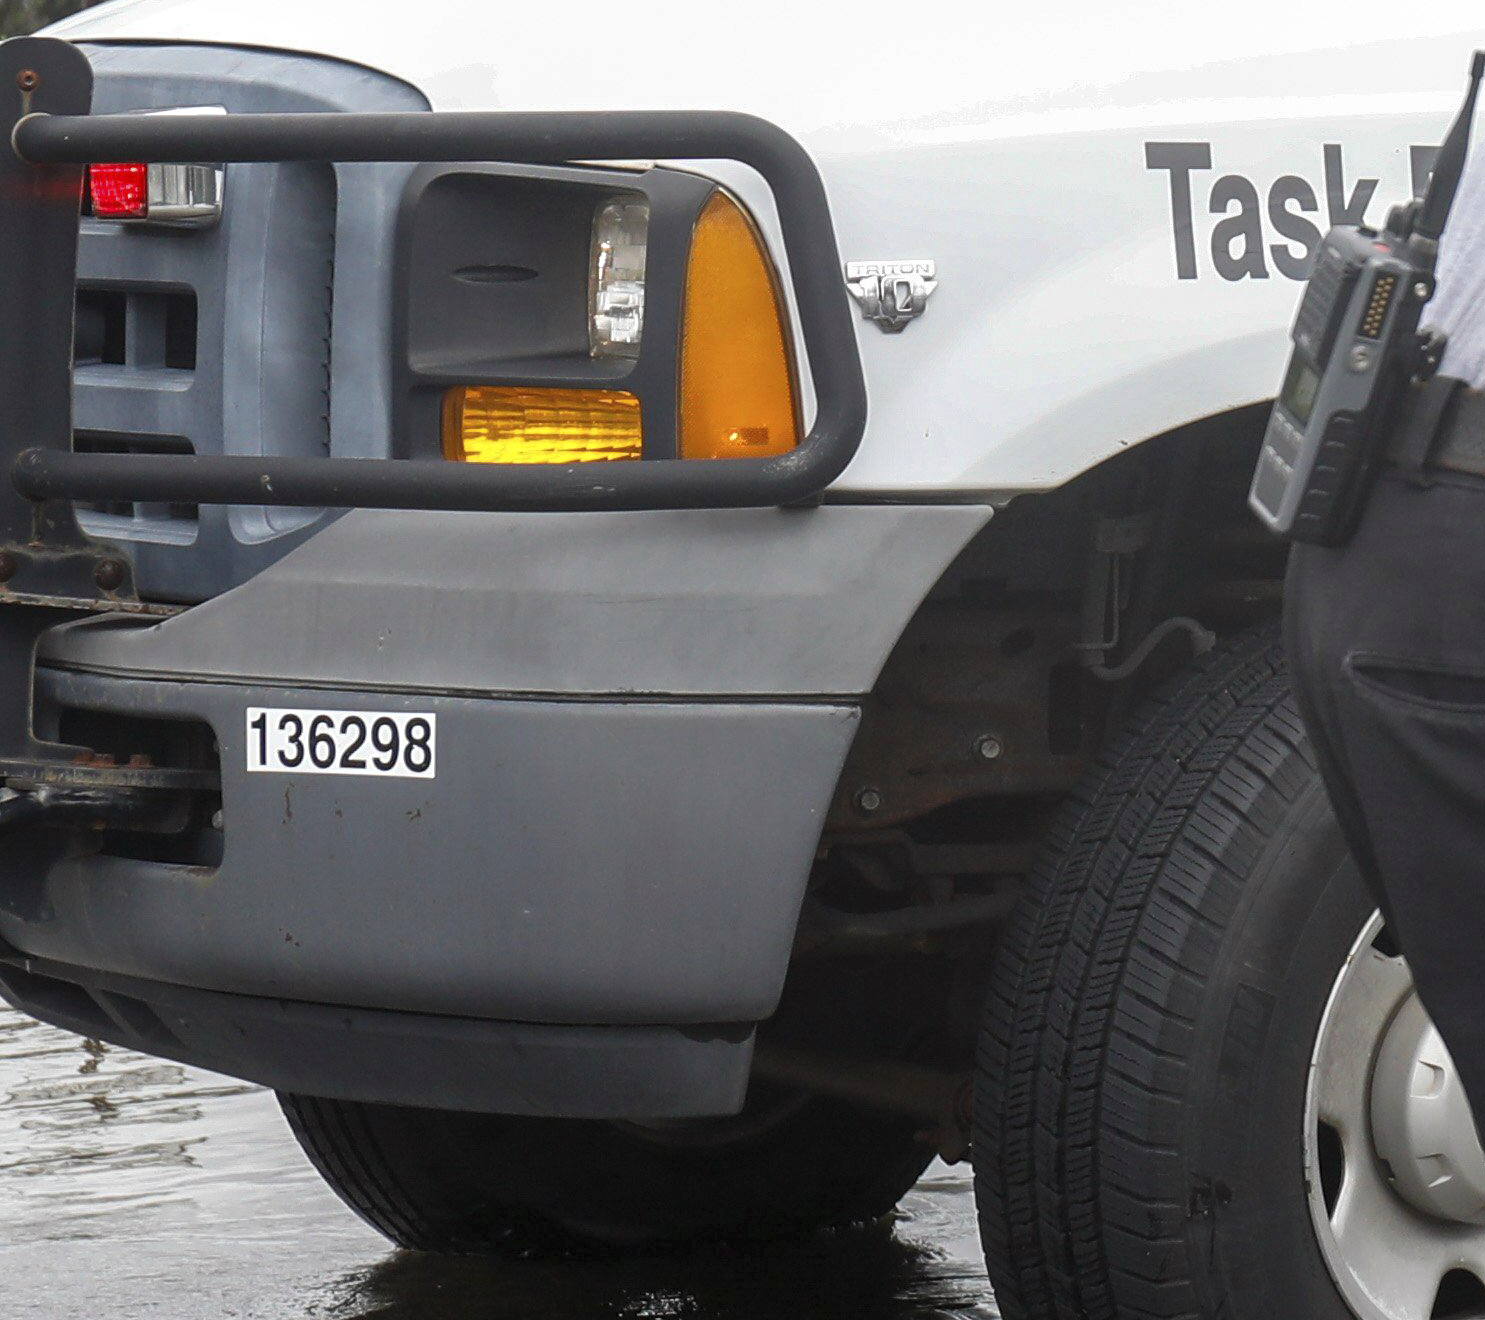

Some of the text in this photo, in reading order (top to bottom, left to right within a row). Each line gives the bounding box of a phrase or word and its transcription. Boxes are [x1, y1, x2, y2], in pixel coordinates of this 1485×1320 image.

[1144, 141, 1381, 281] Task
[852, 263, 930, 275] TRITON
[251, 712, 432, 773] 136298
